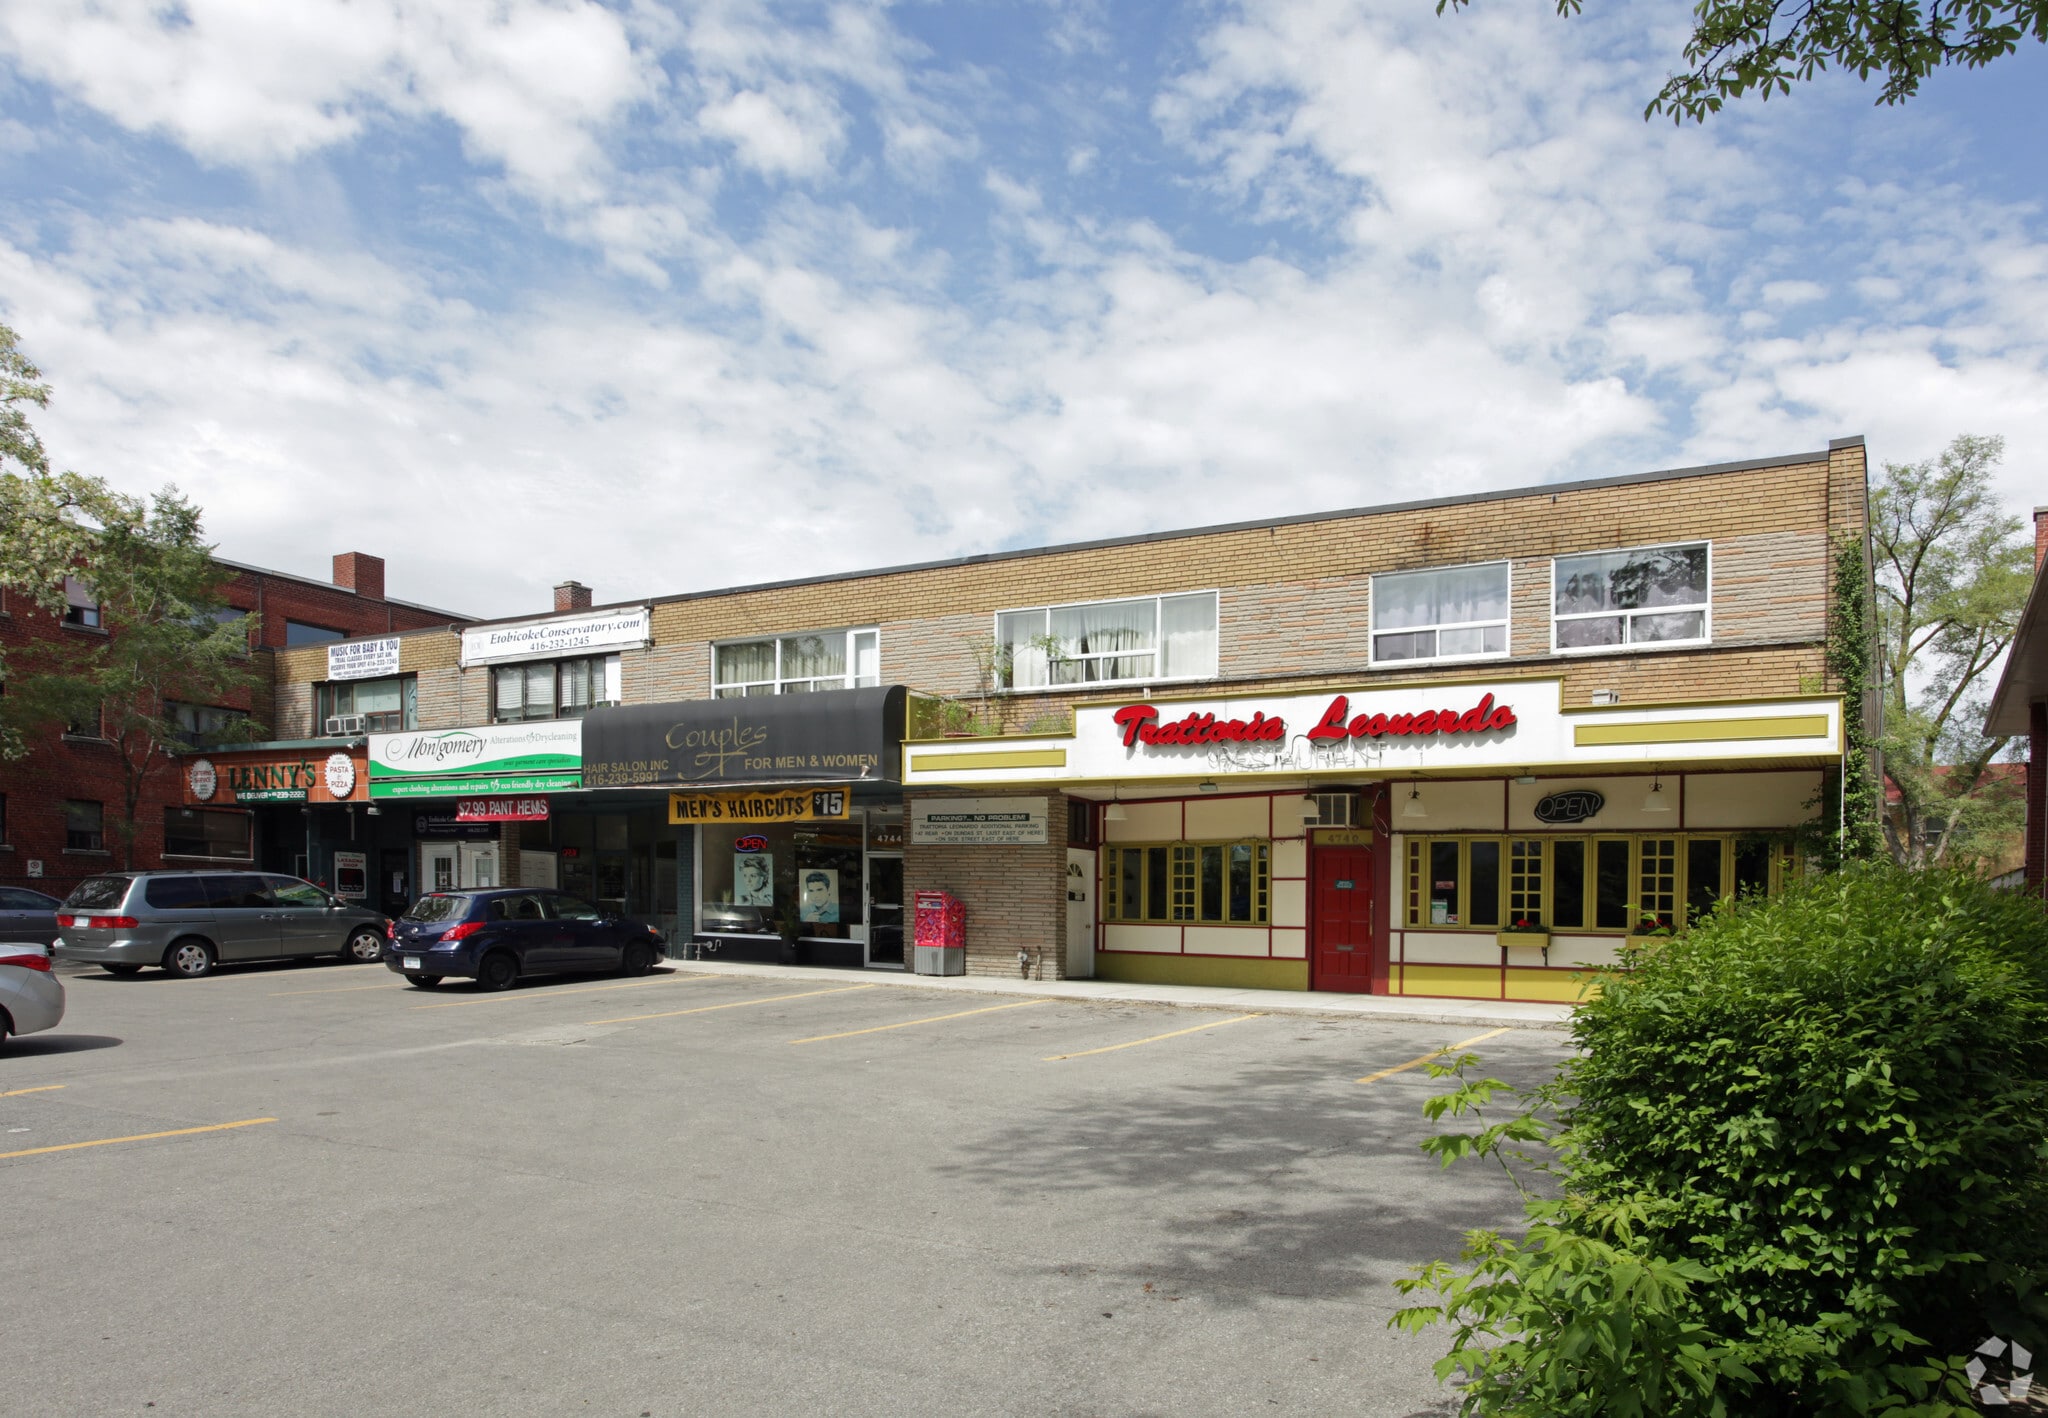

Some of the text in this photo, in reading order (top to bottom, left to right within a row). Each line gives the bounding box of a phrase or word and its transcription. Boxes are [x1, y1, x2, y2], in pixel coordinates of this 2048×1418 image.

[490, 618, 640, 645] EtobicokeConservatory.com
[331, 640, 398, 657] MUSIC FOR BABY & YOU
[530, 636, 590, 651] 416-232-1245
[1113, 694, 1517, 747] Trattoria Leonardo
[490, 732, 577, 745] Alterations Drycleaning
[665, 716, 767, 777] Couples
[386, 736, 488, 762] Montgomery
[583, 760, 669, 774] HAIR SALON INC
[744, 754, 878, 770] FOR MEN & WOMEN
[228, 759, 316, 790] LENNY'S
[584, 772, 659, 785] 416-239-5991
[409, 784, 430, 793] clothing
[431, 783, 458, 791] alterations
[459, 782, 469, 791] and
[470, 782, 489, 792] repairs
[511, 780, 534, 791] friendly
[535, 779, 546, 790] dry
[458, 799, 548, 816] $7.99 PANT HEMS
[677, 793, 842, 818] MEN'S HAIRCUTS $15
[1539, 796, 1596, 817] OPEN
[735, 837, 767, 849] OPEN
[877, 834, 902, 842] 4744
[1328, 834, 1359, 843] 4740
